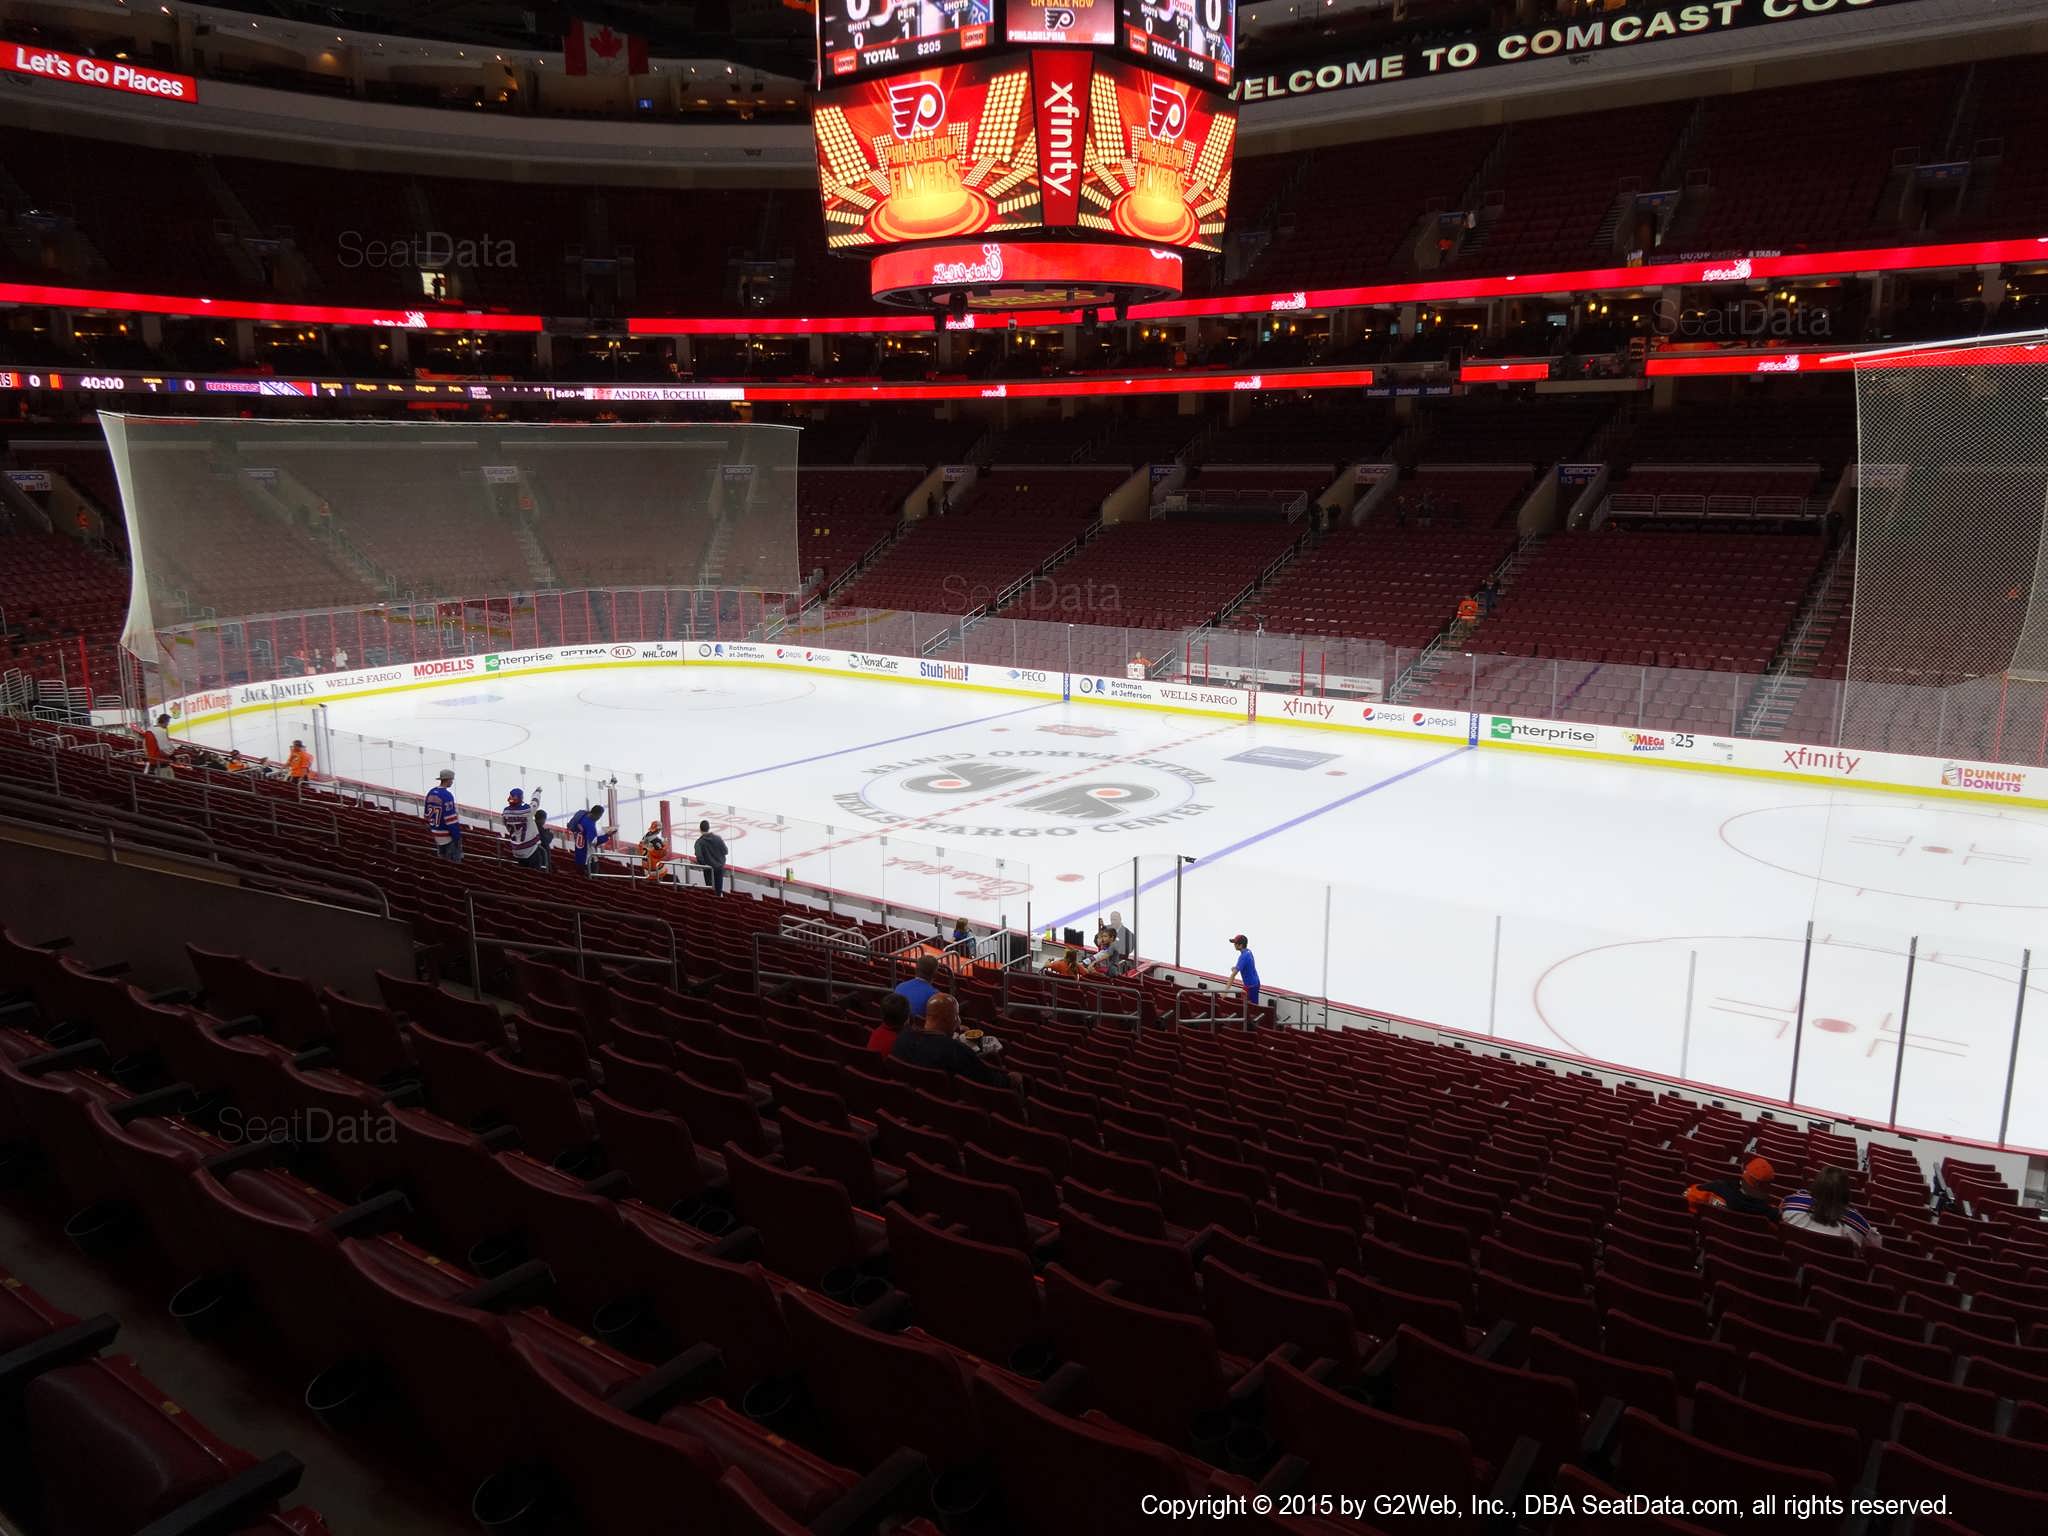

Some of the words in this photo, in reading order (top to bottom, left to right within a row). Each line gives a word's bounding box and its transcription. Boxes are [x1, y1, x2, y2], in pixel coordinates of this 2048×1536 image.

[897, 7, 915, 20] PER
[951, 13, 959, 29] 1
[1146, 17, 1153, 34] 0
[1177, 16, 1189, 29] PER
[902, 23, 910, 39] 1
[1422, 43, 1478, 72] TO
[1498, 0, 1743, 59] COMCAST
[854, 32, 864, 49] 0
[864, 48, 899, 65] TOTAL
[917, 41, 941, 56] $205
[1152, 42, 1177, 62] TOTAL
[1189, 58, 1204, 72] $205
[1210, 43, 1216, 60] 1
[16, 47, 71, 77] Let's
[76, 59, 110, 83] Go
[113, 65, 184, 96] Places
[1044, 81, 1080, 197] xfinity
[884, 137, 960, 162] PHILADELPHIA
[890, 158, 961, 200] FLYERS
[29, 375, 40, 387] 0
[81, 376, 124, 390] 40:00
[185, 380, 195, 392] 0
[614, 389, 659, 401] ANDREA
[663, 388, 706, 401] BOCELLI
[490, 652, 553, 668] enterprise
[560, 647, 607, 658] OPTIMA
[614, 648, 633, 657] KIA
[642, 649, 678, 659] NHL.COM
[413, 658, 475, 677] MODELL'S
[860, 655, 899, 669] NovaCare
[920, 661, 968, 681] StubHub!
[1021, 670, 1046, 683] PECO
[326, 677, 364, 689] WELLS
[365, 671, 402, 683] FARGO
[1111, 680, 1143, 691] Rothman
[240, 686, 269, 704] JACK
[1118, 690, 1152, 700] Jefferson
[1160, 689, 1198, 702] WELLS
[1200, 692, 1238, 706] FARGO
[1283, 699, 1335, 720] xfinity
[1377, 711, 1406, 723] pepsi
[1427, 715, 1457, 729] pepsi
[1497, 720, 1595, 743] enterprise
[1636, 733, 1665, 747] MEGA
[861, 750, 976, 775] CENTER
[989, 749, 1119, 760] FARGO
[1783, 747, 1861, 774] xfinity
[1133, 757, 1216, 786] WELLS
[1964, 767, 2027, 783] DUNKIN'
[1963, 779, 2022, 793] DONUTS
[832, 792, 907, 825] WELLS
[912, 821, 1078, 838] FARGO
[1093, 803, 1214, 834] CENTER
